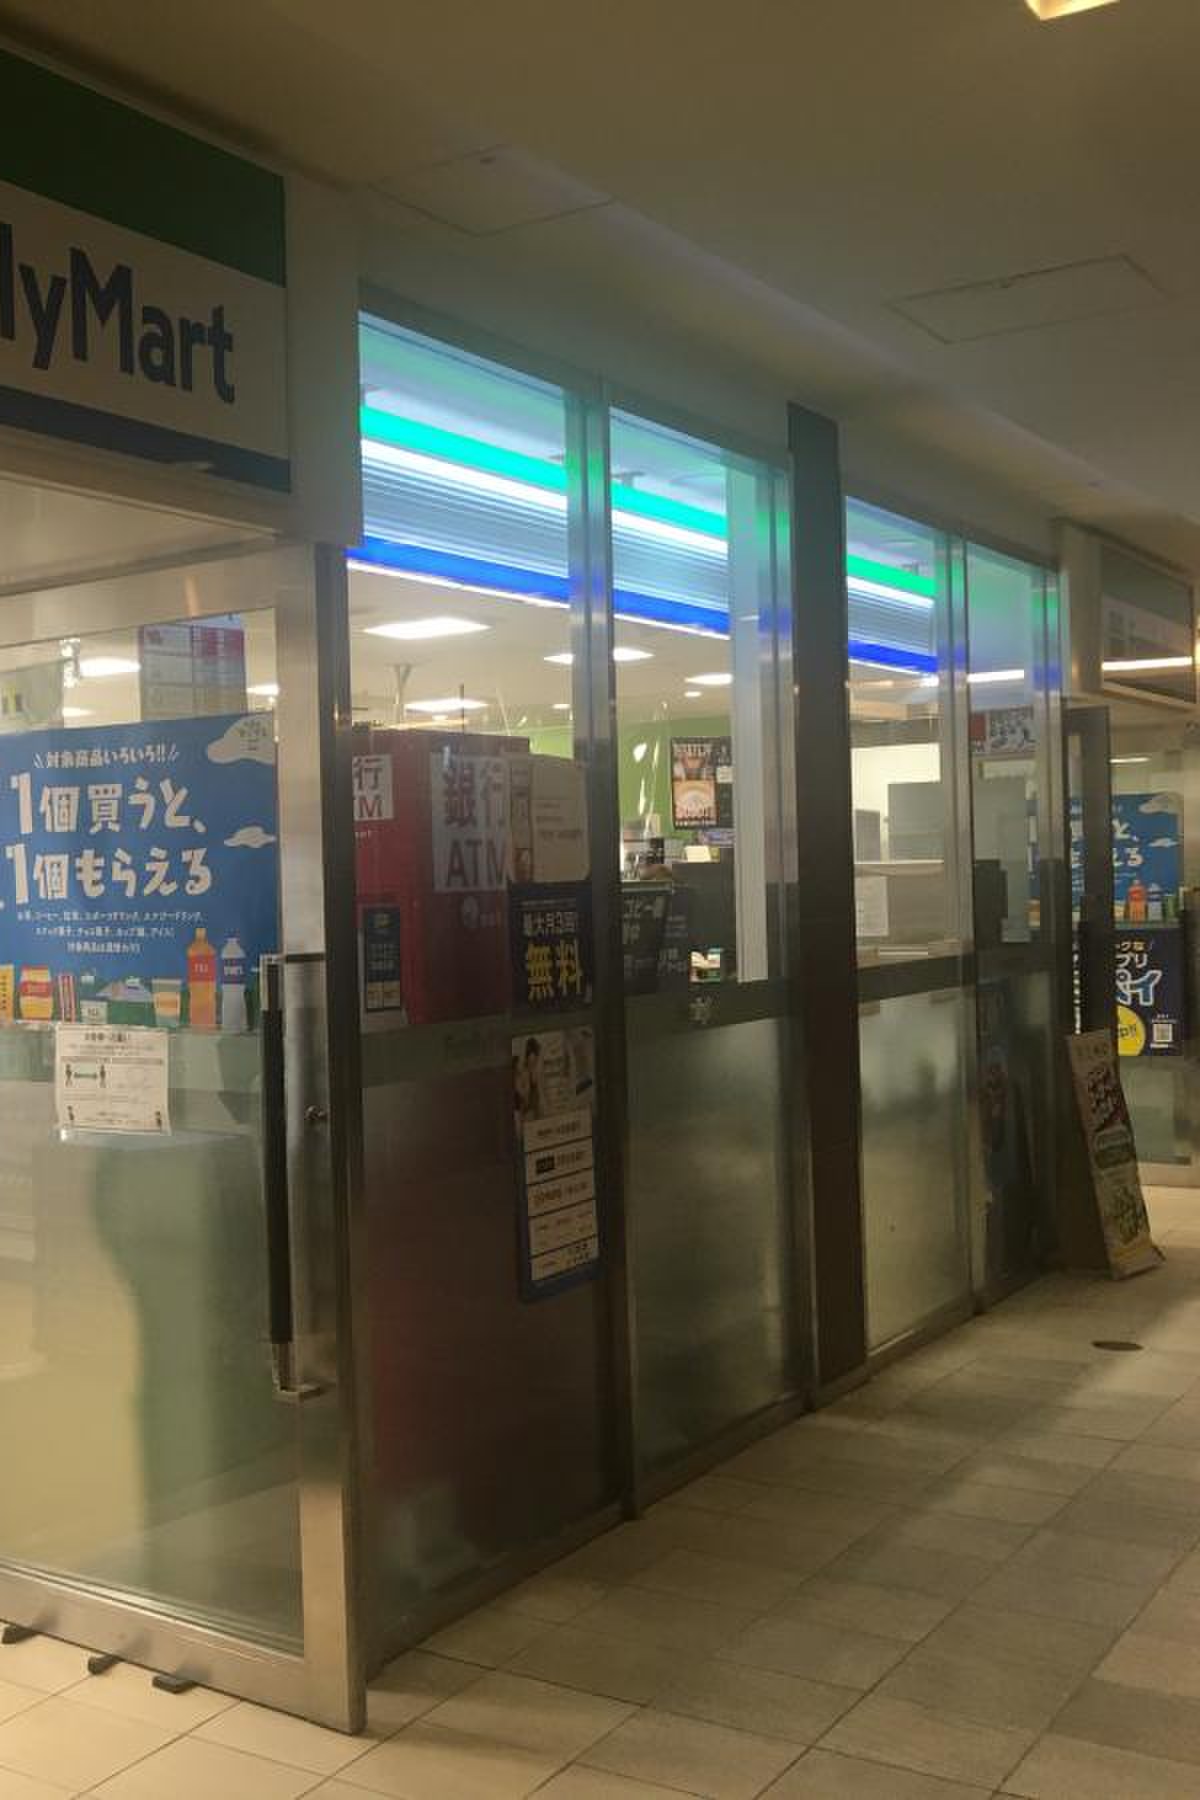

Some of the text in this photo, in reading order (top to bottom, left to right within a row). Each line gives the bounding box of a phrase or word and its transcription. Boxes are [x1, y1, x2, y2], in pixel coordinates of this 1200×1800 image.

[10, 772, 207, 834] 1個買うと、
[354, 797, 383, 818] M
[5, 843, 213, 904] 1個もらえる
[525, 939, 585, 999] 無料
